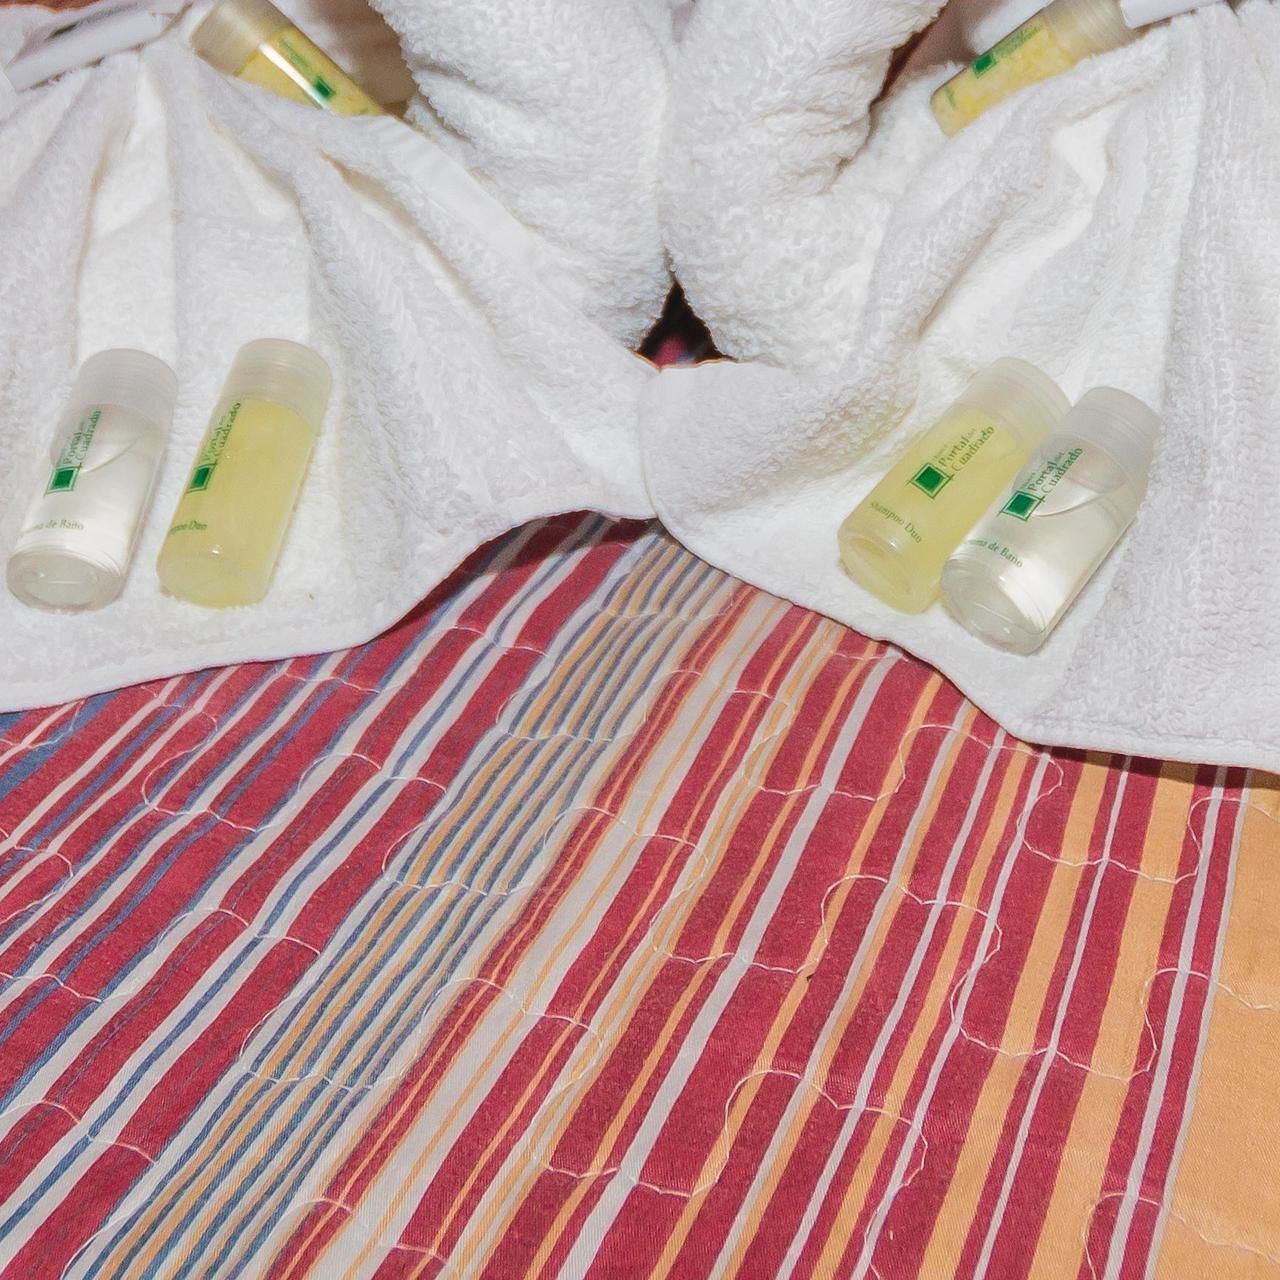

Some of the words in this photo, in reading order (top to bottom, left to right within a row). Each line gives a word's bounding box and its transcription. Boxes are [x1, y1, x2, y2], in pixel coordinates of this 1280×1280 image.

[938, 436, 969, 467] Portal
[951, 426, 994, 472] Cuadrado
[1027, 461, 1057, 491] Portal
[1041, 447, 1083, 494] Cuadrado
